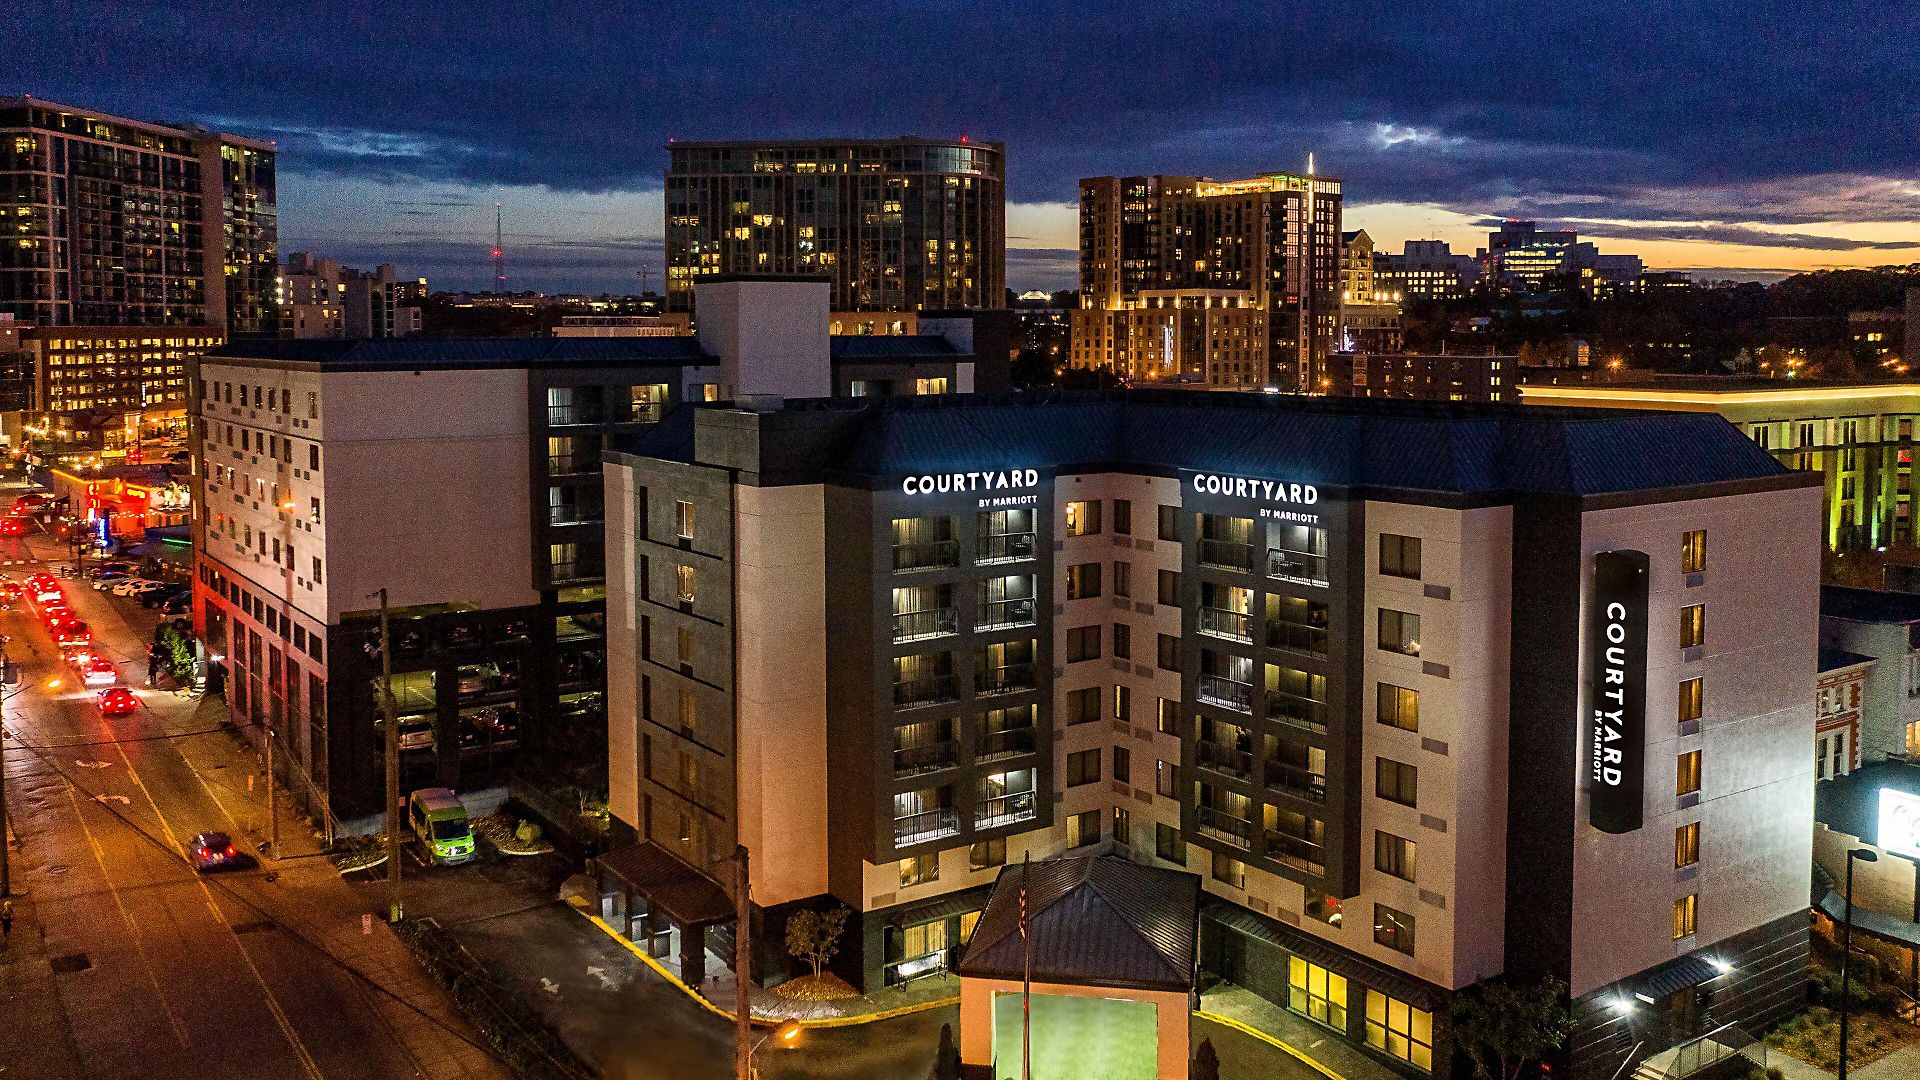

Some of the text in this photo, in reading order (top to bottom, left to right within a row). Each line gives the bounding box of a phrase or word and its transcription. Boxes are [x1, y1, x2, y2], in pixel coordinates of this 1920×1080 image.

[903, 470, 1039, 496] COURTYARD
[1194, 474, 1318, 505] COURTYARD
[978, 495, 1038, 508] BY MARRIOTT
[1259, 508, 1319, 524] BY MARRIOTT
[1604, 602, 1626, 786] COURTYARD
[1593, 709, 1603, 783] BY MARRIOTT
